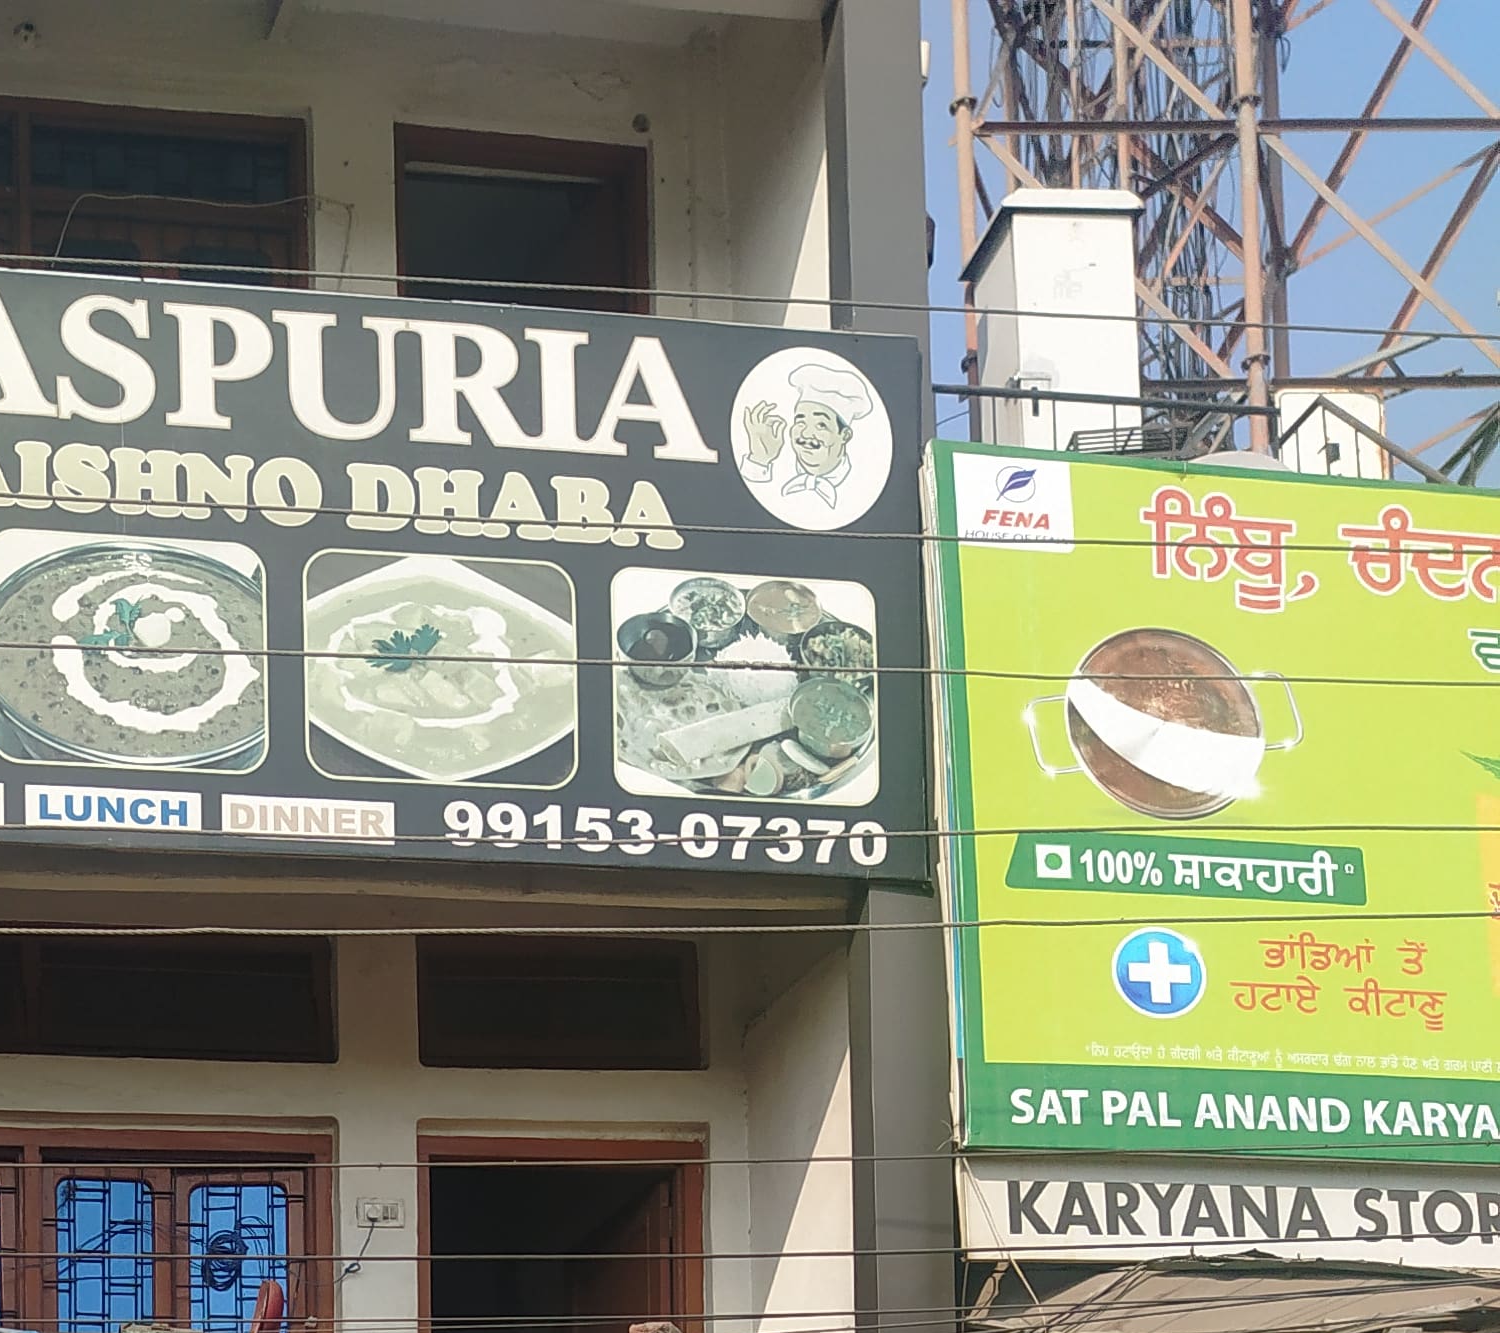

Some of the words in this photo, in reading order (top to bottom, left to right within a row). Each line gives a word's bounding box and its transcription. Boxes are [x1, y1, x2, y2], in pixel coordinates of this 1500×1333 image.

[345, 463, 684, 549] DHABA
[982, 509, 1050, 530] FENA
[38, 792, 189, 828] LUNCH
[230, 803, 386, 837] DINNER
[443, 800, 888, 866] 99153-07370
[1079, 849, 1162, 887] 100%
[1010, 1088, 1089, 1125] SAT
[1101, 1089, 1182, 1130] PAL
[1194, 1093, 1351, 1134] ANAND
[1363, 1099, 1500, 1140] KARYA
[1007, 1180, 1332, 1240] KARYANA
